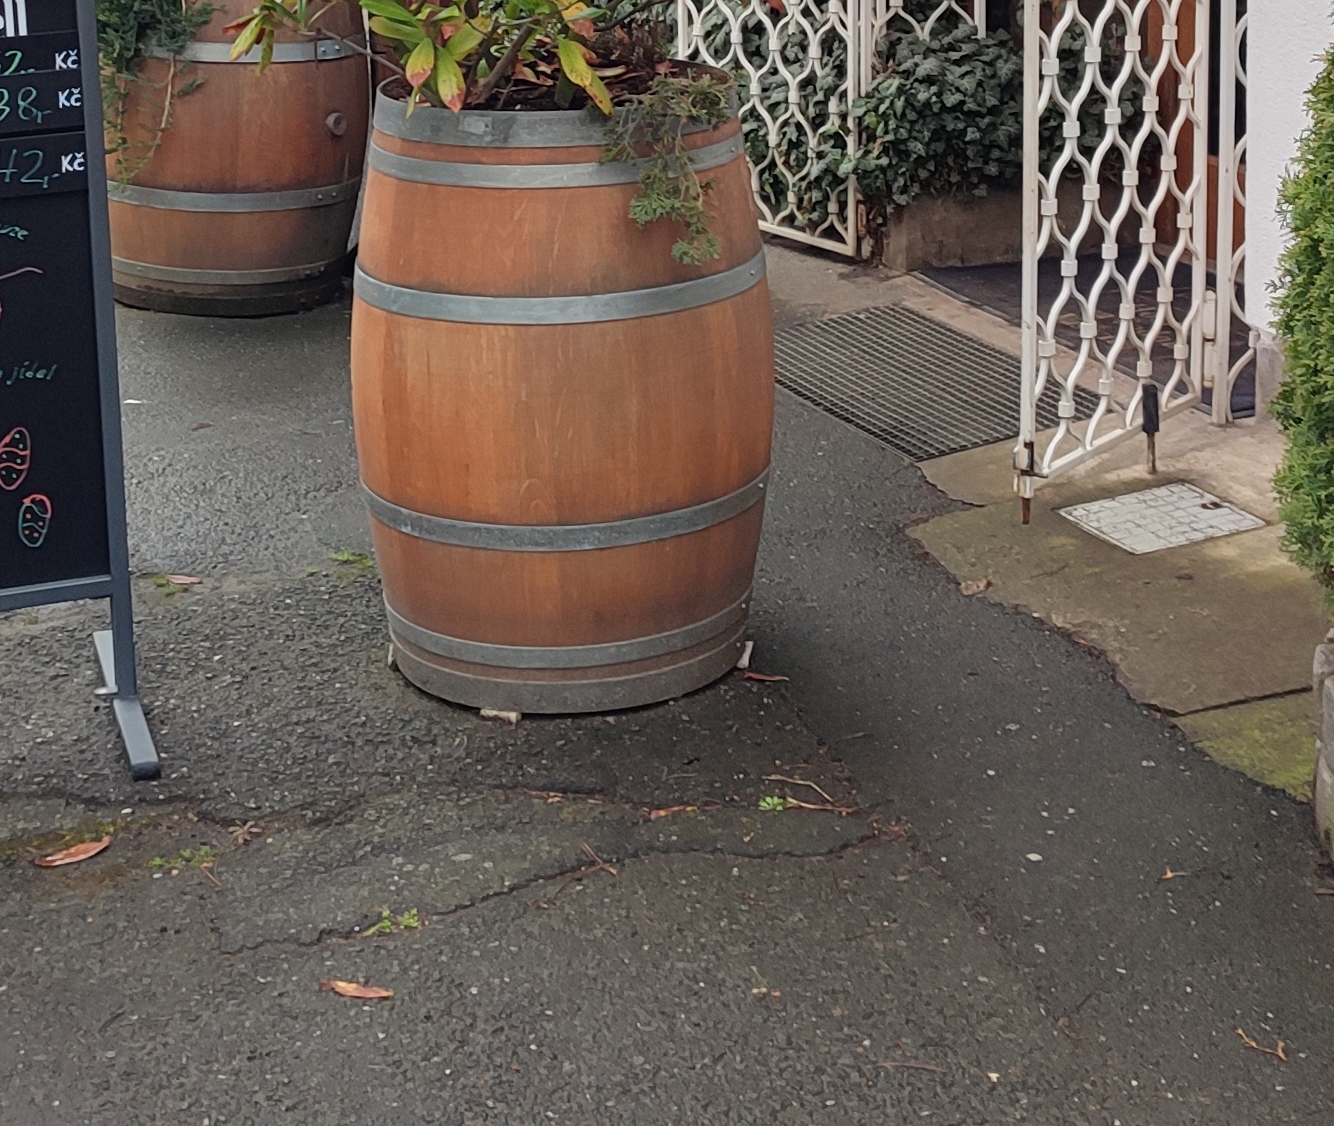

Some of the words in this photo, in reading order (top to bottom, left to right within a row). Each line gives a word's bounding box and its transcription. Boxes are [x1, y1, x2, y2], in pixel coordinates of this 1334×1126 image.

[55, 49, 79, 70] Kč
[58, 87, 82, 108] Kč
[61, 152, 85, 173] Kč
